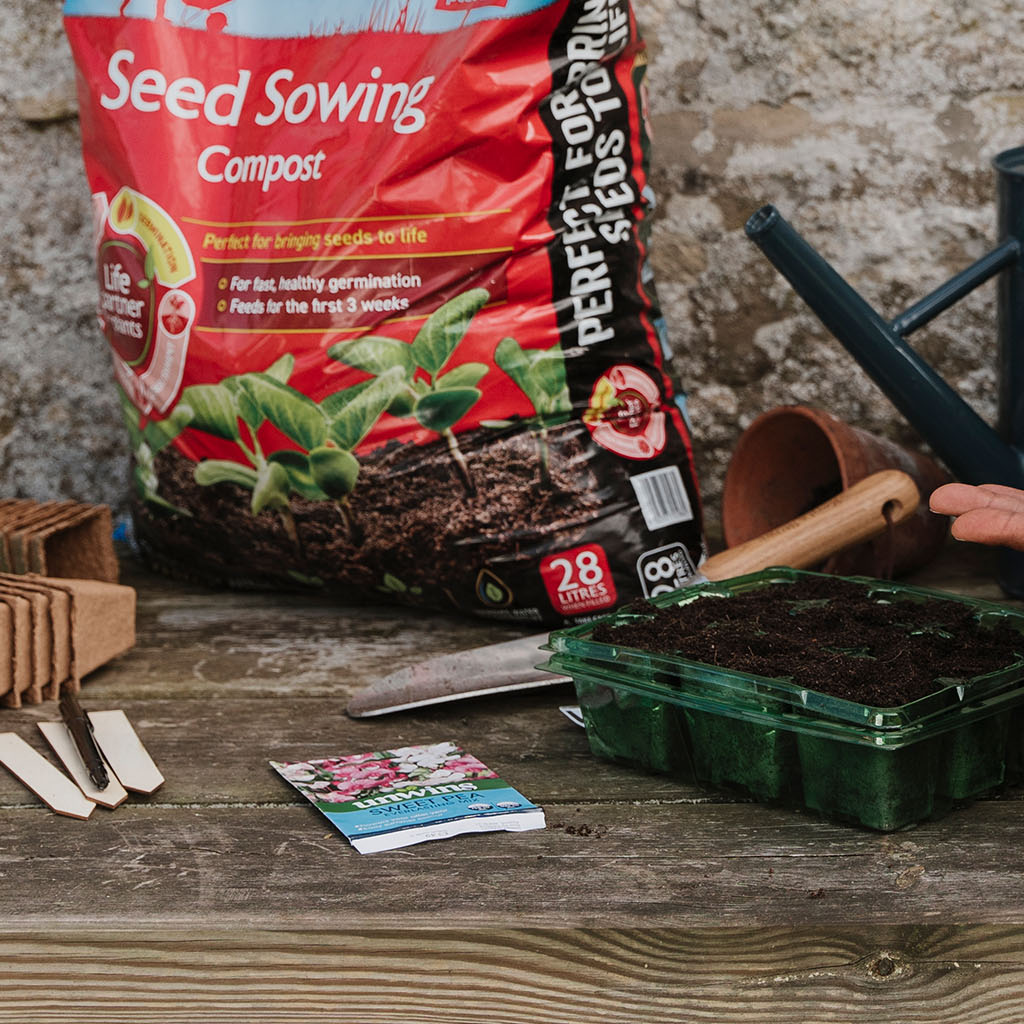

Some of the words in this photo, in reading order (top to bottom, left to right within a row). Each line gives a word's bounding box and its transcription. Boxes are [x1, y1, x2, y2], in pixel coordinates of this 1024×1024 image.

[100, 49, 251, 127] Seed
[254, 66, 436, 134] Sowing
[580, 67, 622, 123] TO
[550, 88, 595, 171] FOR
[197, 145, 326, 192] Compost
[202, 232, 250, 250] Perfect
[252, 232, 273, 249] for
[273, 231, 321, 252] bringing
[324, 228, 373, 247] seeds
[377, 230, 396, 245] to
[400, 226, 428, 244] life
[103, 262, 131, 294] Life
[558, 184, 615, 347] PERFECT
[230, 276, 252, 292] For
[278, 274, 326, 294] healthy
[328, 272, 422, 294] germination
[229, 298, 265, 315] Feeds
[266, 298, 284, 314] for
[285, 297, 309, 314] the
[311, 297, 343, 314] first
[346, 297, 358, 313] 3
[361, 295, 410, 312] weeks
[550, 550, 604, 593] 28
[557, 582, 609, 605] LITRES
[352, 782, 478, 809] unwins
[369, 797, 437, 816] SWEET
[442, 792, 486, 803] PEA
